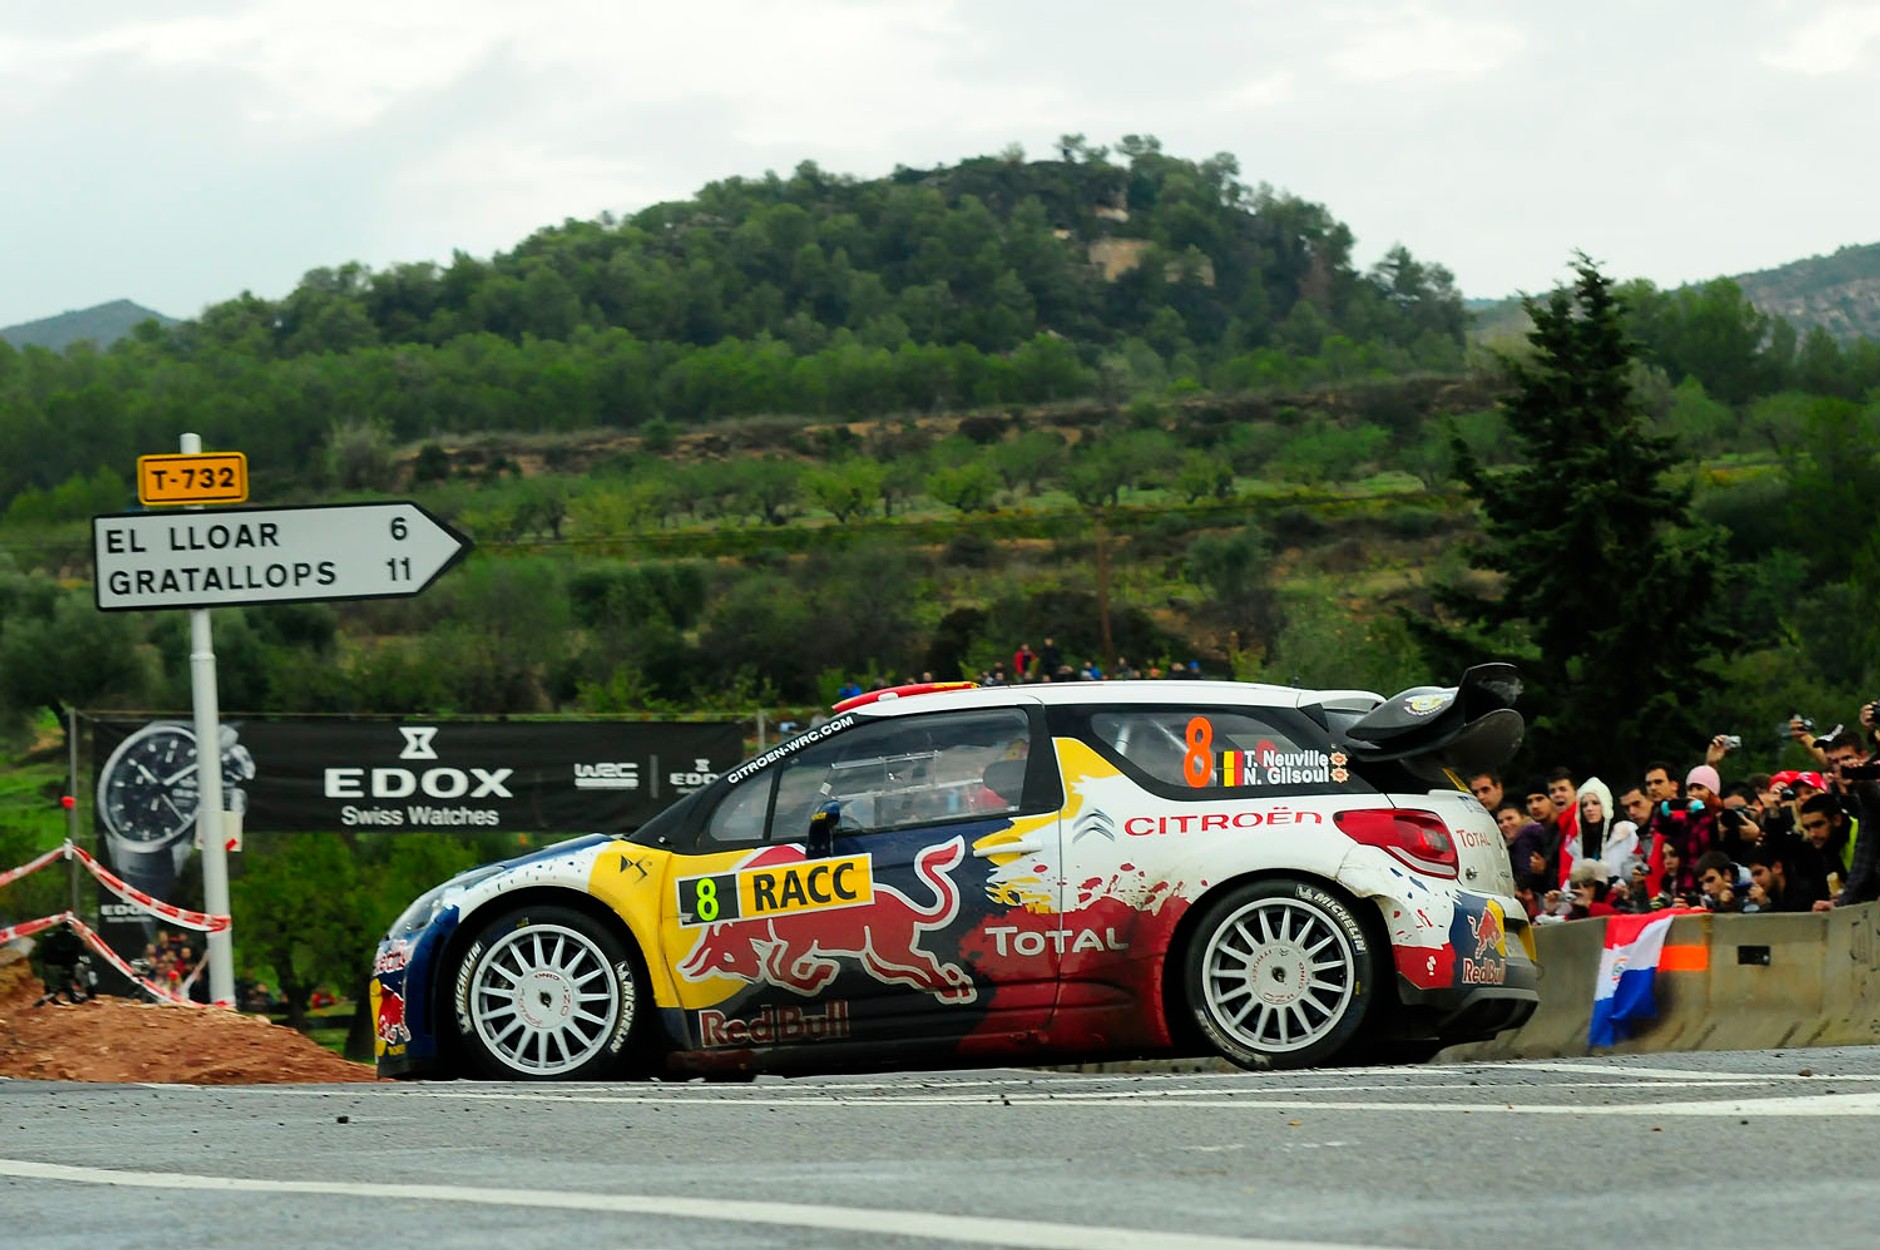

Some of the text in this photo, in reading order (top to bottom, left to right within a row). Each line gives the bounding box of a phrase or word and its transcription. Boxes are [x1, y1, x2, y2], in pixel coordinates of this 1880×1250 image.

[151, 467, 236, 491] T-732
[106, 516, 408, 554] EL LLOAR 6
[108, 556, 412, 596] GRATALLOPS 11
[727, 715, 855, 784] CITROEN-WRC.COM
[1183, 715, 1214, 789] 8
[1243, 749, 1330, 768] T. Neuville
[324, 767, 514, 799] EDOX
[573, 762, 639, 778] WRC
[669, 772, 720, 786] EDO
[1243, 766, 1331, 786] N. Gilsoul
[340, 804, 500, 826] Swiss Watches
[695, 877, 721, 922] 8
[752, 862, 858, 911] RACC
[1313, 892, 1367, 952] MICHELIN
[984, 925, 1130, 957] TOTAL
[455, 941, 483, 1015] MICHELIN
